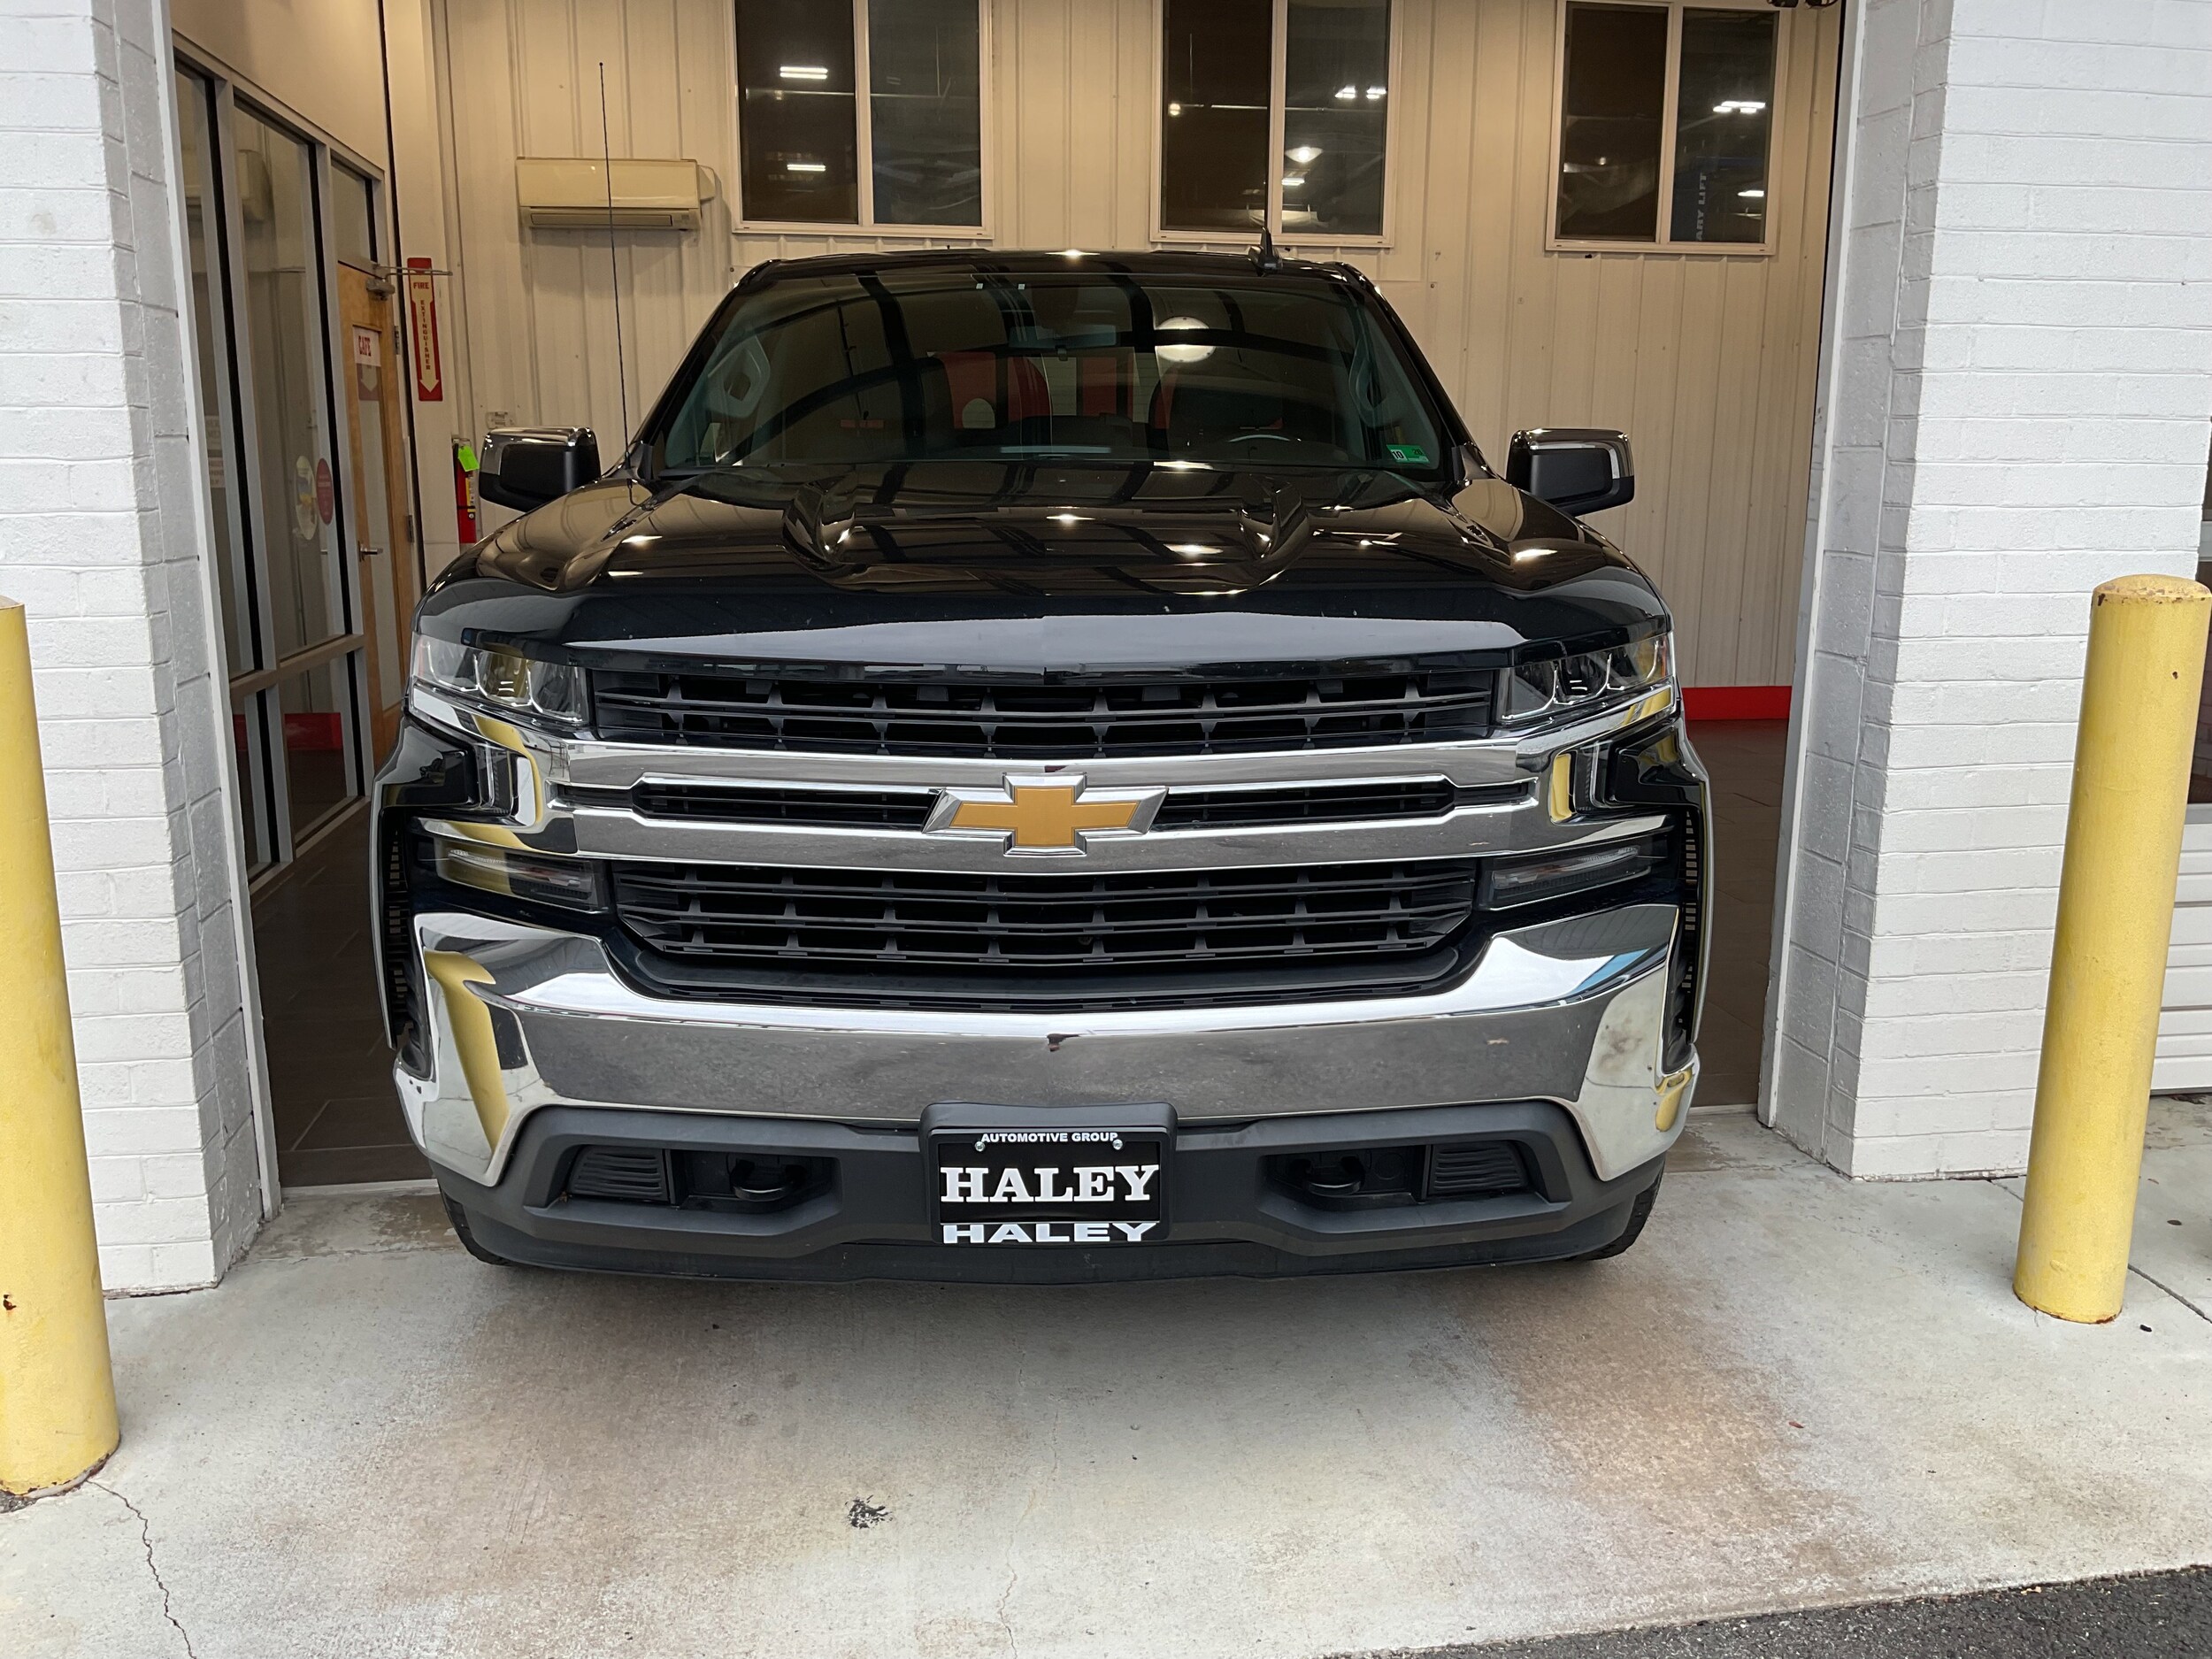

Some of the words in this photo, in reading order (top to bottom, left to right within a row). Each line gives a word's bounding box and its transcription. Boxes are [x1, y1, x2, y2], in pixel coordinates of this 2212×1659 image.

[1698, 172, 1707, 204] LIFT
[420, 300, 431, 370] EXTINGUISHER
[1392, 450, 1404, 459] 10
[980, 1133, 1068, 1143] AUTOMOTIVE
[1071, 1132, 1118, 1142] GROUP
[940, 1164, 1159, 1202] HALEY
[943, 1223, 1157, 1244] HALEY
